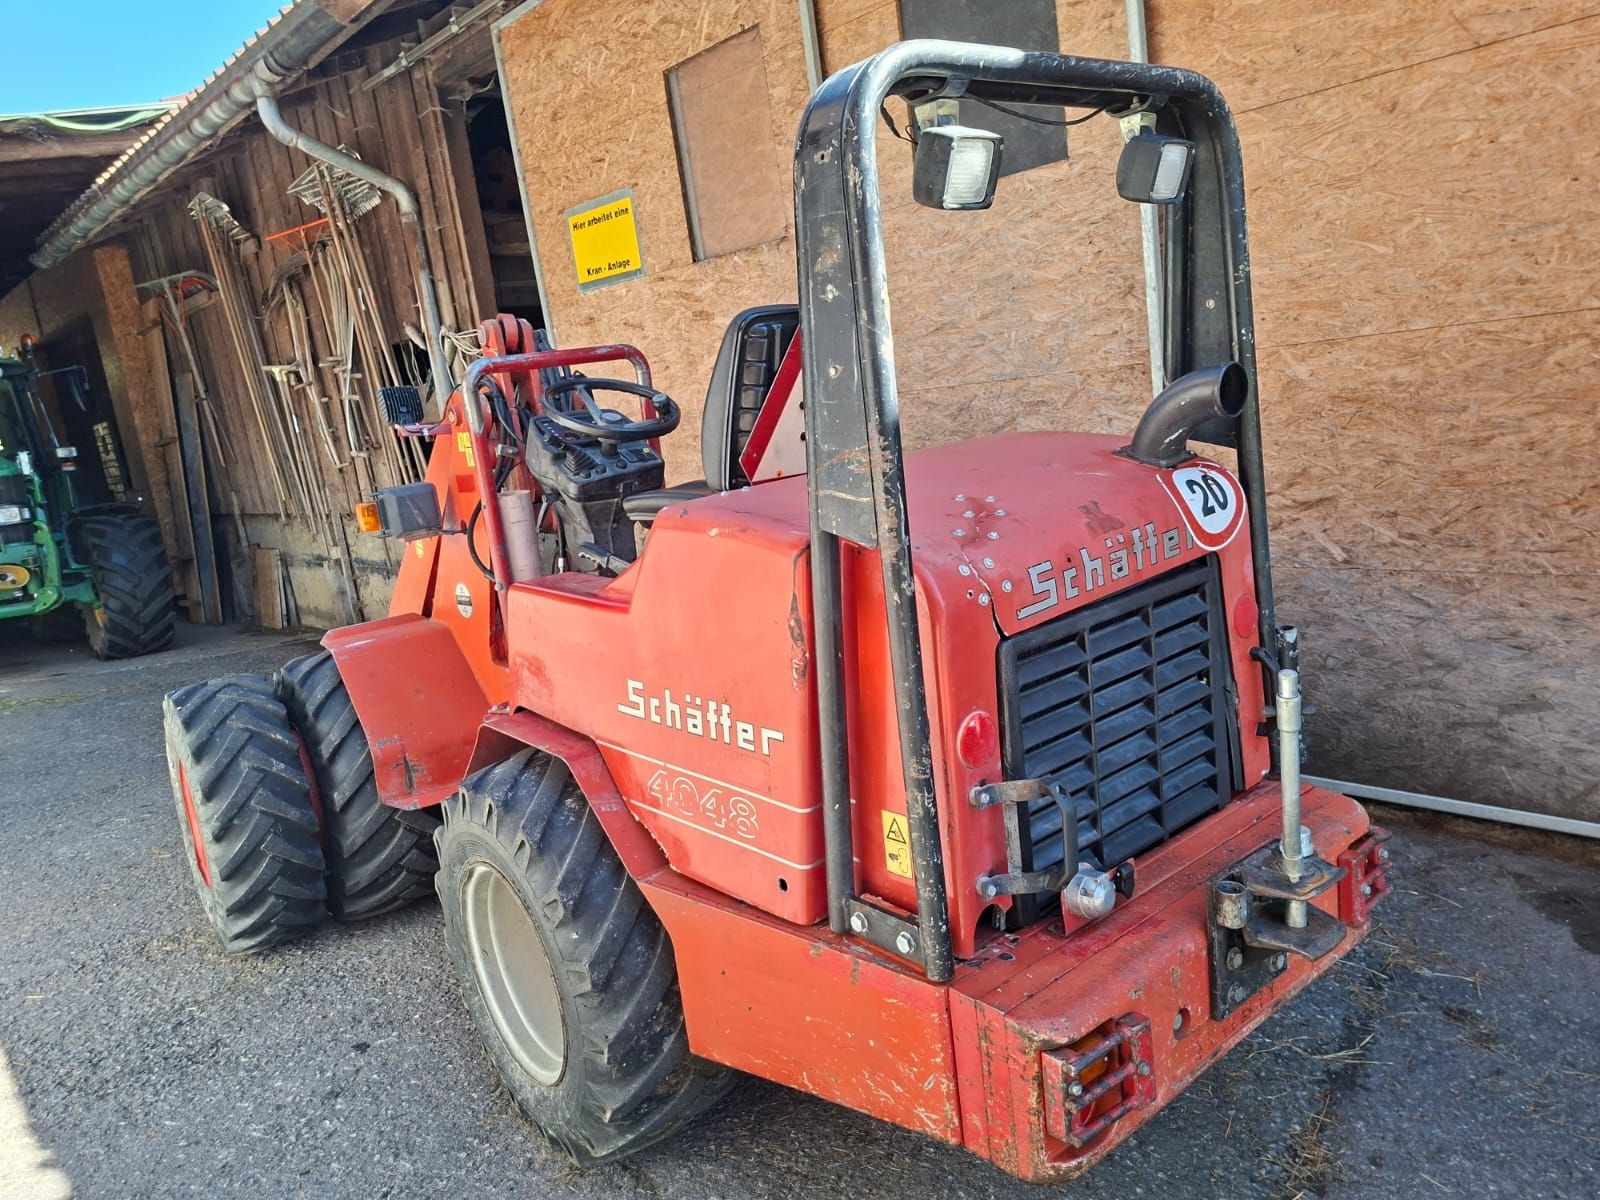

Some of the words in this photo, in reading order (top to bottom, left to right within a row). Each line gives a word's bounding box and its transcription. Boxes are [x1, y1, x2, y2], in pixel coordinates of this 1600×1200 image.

[573, 223, 586, 231] Hier
[588, 211, 612, 226] arbeitet
[615, 207, 629, 217] eine
[587, 266, 603, 276] Kran
[608, 259, 630, 270] Anlage
[1185, 474, 1229, 518] 20
[617, 678, 784, 757] Schäffer
[647, 769, 760, 840] 4048
